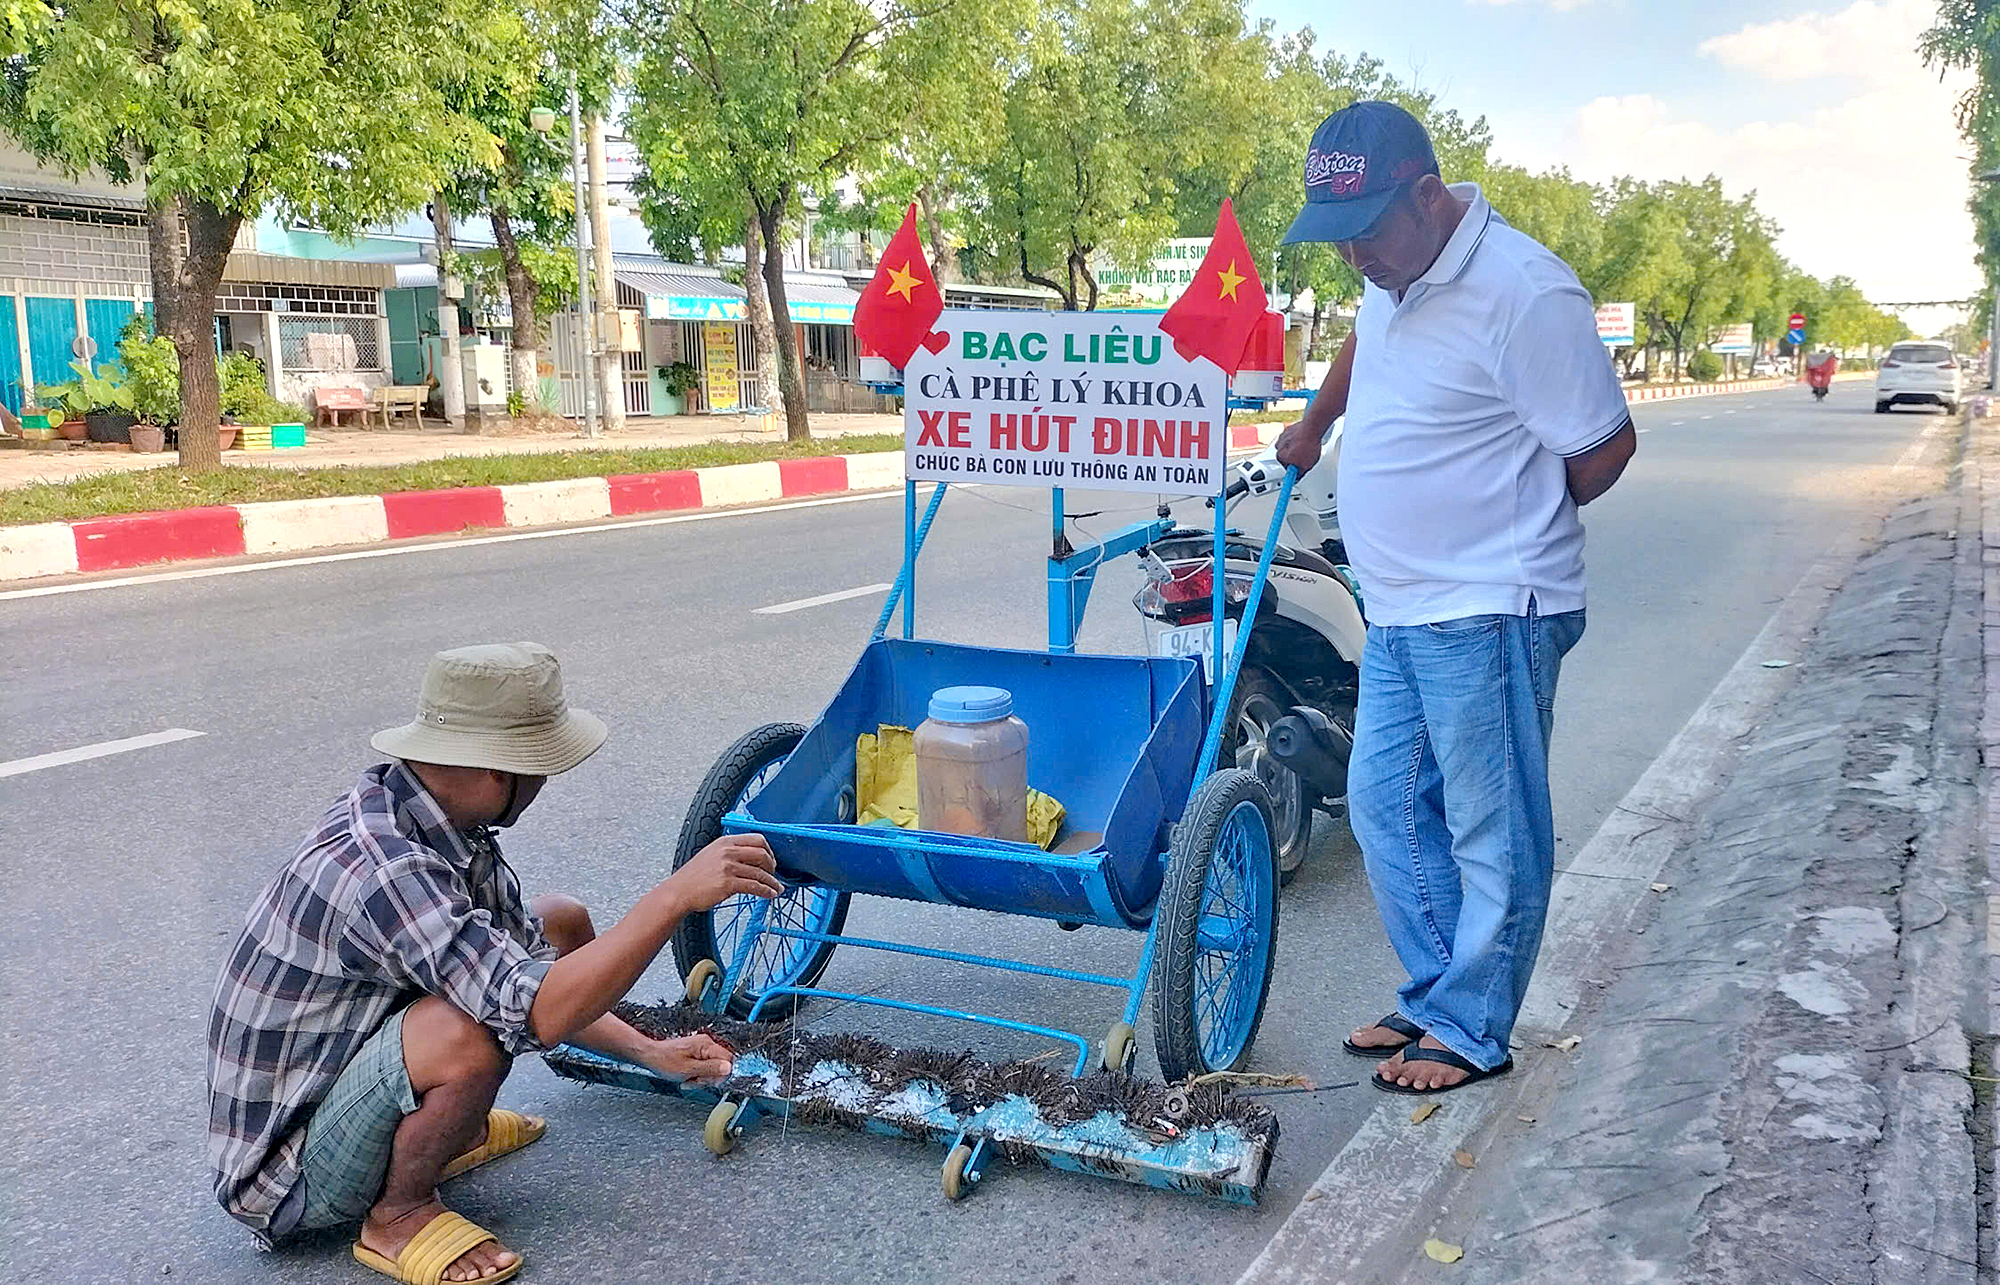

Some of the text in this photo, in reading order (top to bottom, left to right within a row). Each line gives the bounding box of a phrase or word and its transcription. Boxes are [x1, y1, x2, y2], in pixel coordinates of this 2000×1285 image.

[962, 325, 1162, 368] BẠC LIÊU
[920, 366, 1206, 409] CÀ PHÊ LÝ KHOA
[916, 406, 1211, 460] XE HÚT ĐINH
[915, 451, 1210, 485] CHÚC BÀ CON LƯU THÔNG AN TOÀN
